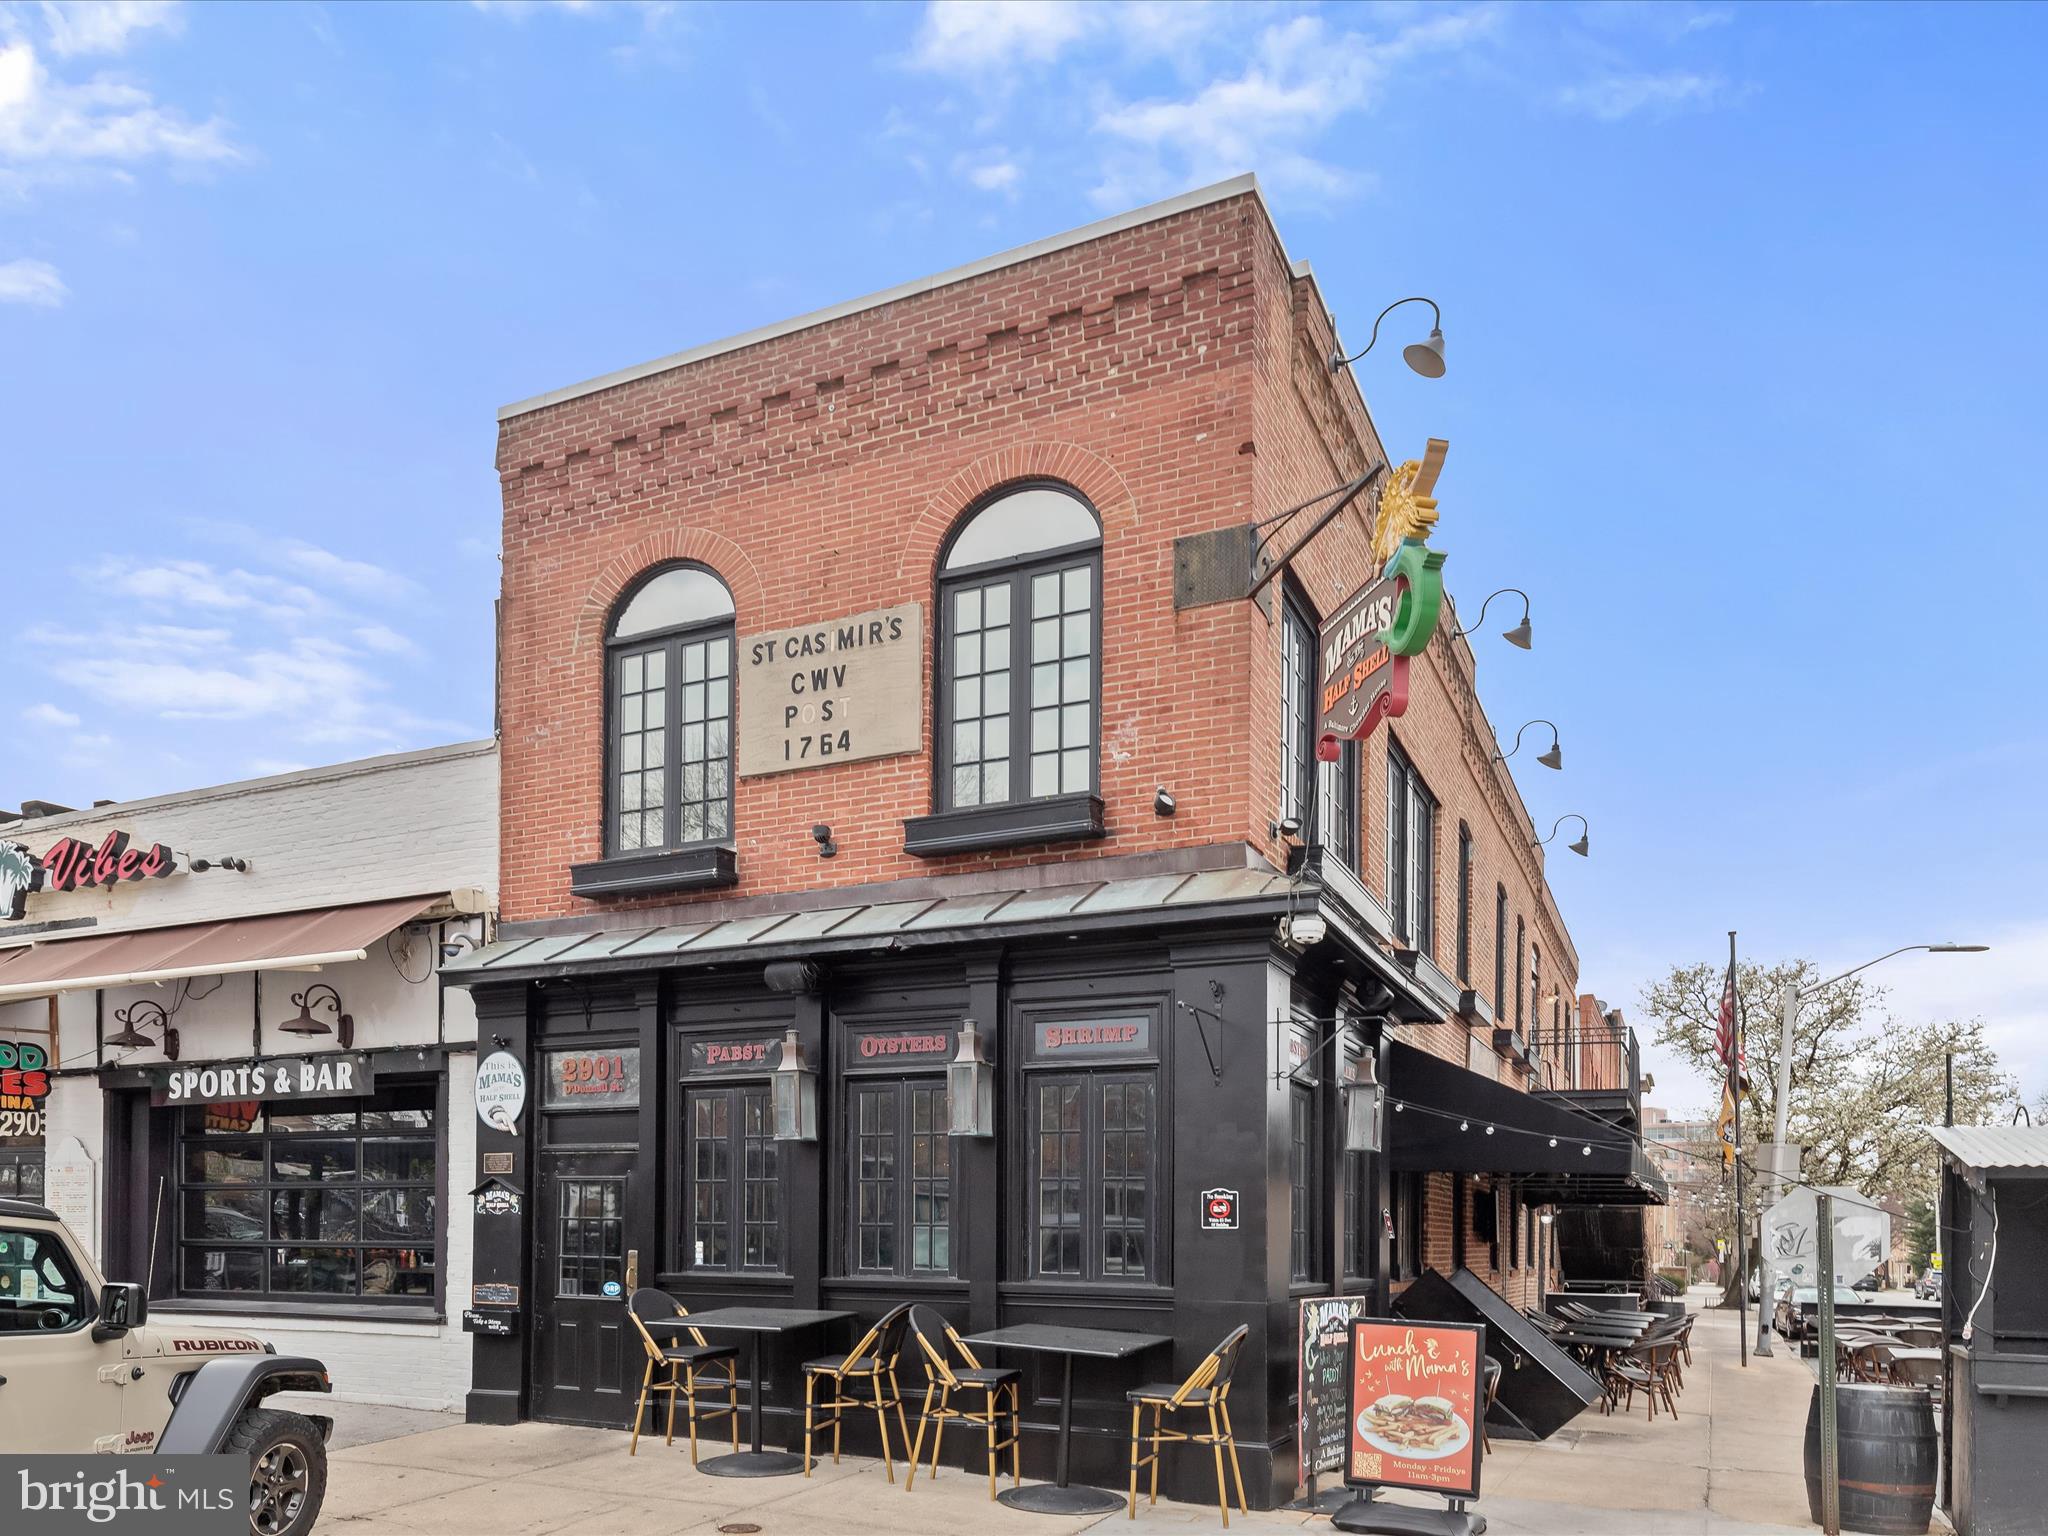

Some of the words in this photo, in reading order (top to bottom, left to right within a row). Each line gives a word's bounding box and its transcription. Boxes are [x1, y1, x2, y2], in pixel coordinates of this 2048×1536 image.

[752, 640, 777, 666] ST
[785, 616, 903, 658] CASIMIR'S
[1323, 596, 1393, 685] MAMA'S
[791, 664, 847, 694] CWV
[1323, 673, 1351, 714] HALF
[1353, 644, 1389, 690] SHELL
[785, 697, 851, 728] POST
[784, 730, 851, 761] 1764
[42, 829, 168, 892] Vibes
[860, 1035, 947, 1057] OYSTERS
[1045, 1025, 1138, 1048] SHRIMP
[485, 1062, 505, 1070] This
[706, 1044, 766, 1064] PABST
[168, 1066, 266, 1100] SPORTS
[273, 1067, 291, 1095] &
[300, 1062, 353, 1092] BAR
[479, 1072, 522, 1089] MAMA'S
[561, 1055, 624, 1082] 2901
[0, 1069, 48, 1096] ES
[480, 1094, 497, 1103] HALF
[499, 1093, 521, 1102] SHELL
[485, 1190, 511, 1201] MAMA'S
[1319, 1301, 1350, 1328] MAMA'S
[173, 1340, 260, 1351] RUBICON
[1360, 1329, 1419, 1361] Lunch
[1384, 1357, 1404, 1373] with
[1406, 1350, 1470, 1381] Mama's
[125, 1431, 154, 1445] Jeep
[1392, 1460, 1427, 1472] Monday
[1433, 1464, 1466, 1476] Fridays
